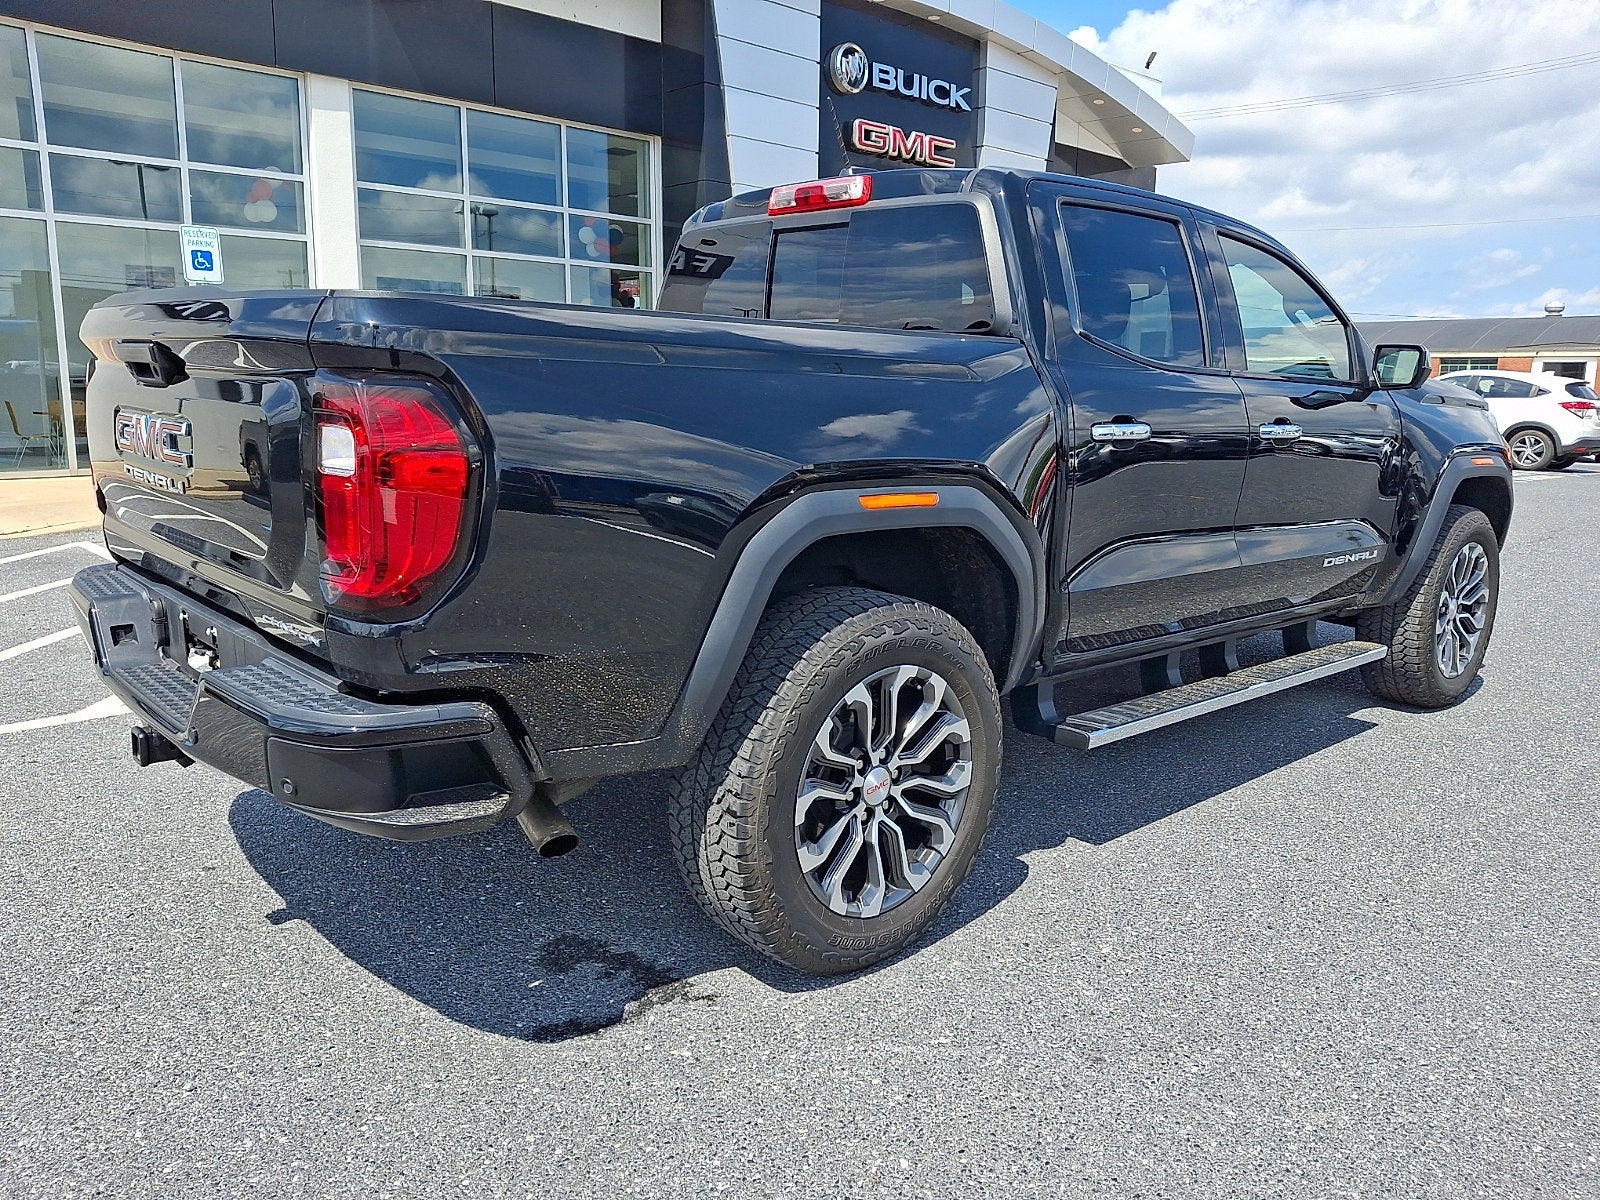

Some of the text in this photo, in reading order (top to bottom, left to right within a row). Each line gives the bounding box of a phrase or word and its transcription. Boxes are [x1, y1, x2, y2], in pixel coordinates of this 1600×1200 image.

[872, 61, 972, 112] BUICK
[852, 118, 956, 168] GMC
[183, 229, 217, 240] RESERVED
[187, 239, 214, 249] PARKING
[115, 412, 193, 468] GMC
[123, 463, 186, 495] DENALI
[1322, 549, 1378, 568] DENALI
[866, 778, 889, 795] GMC
[827, 874, 954, 950] BRIDGESTONE
